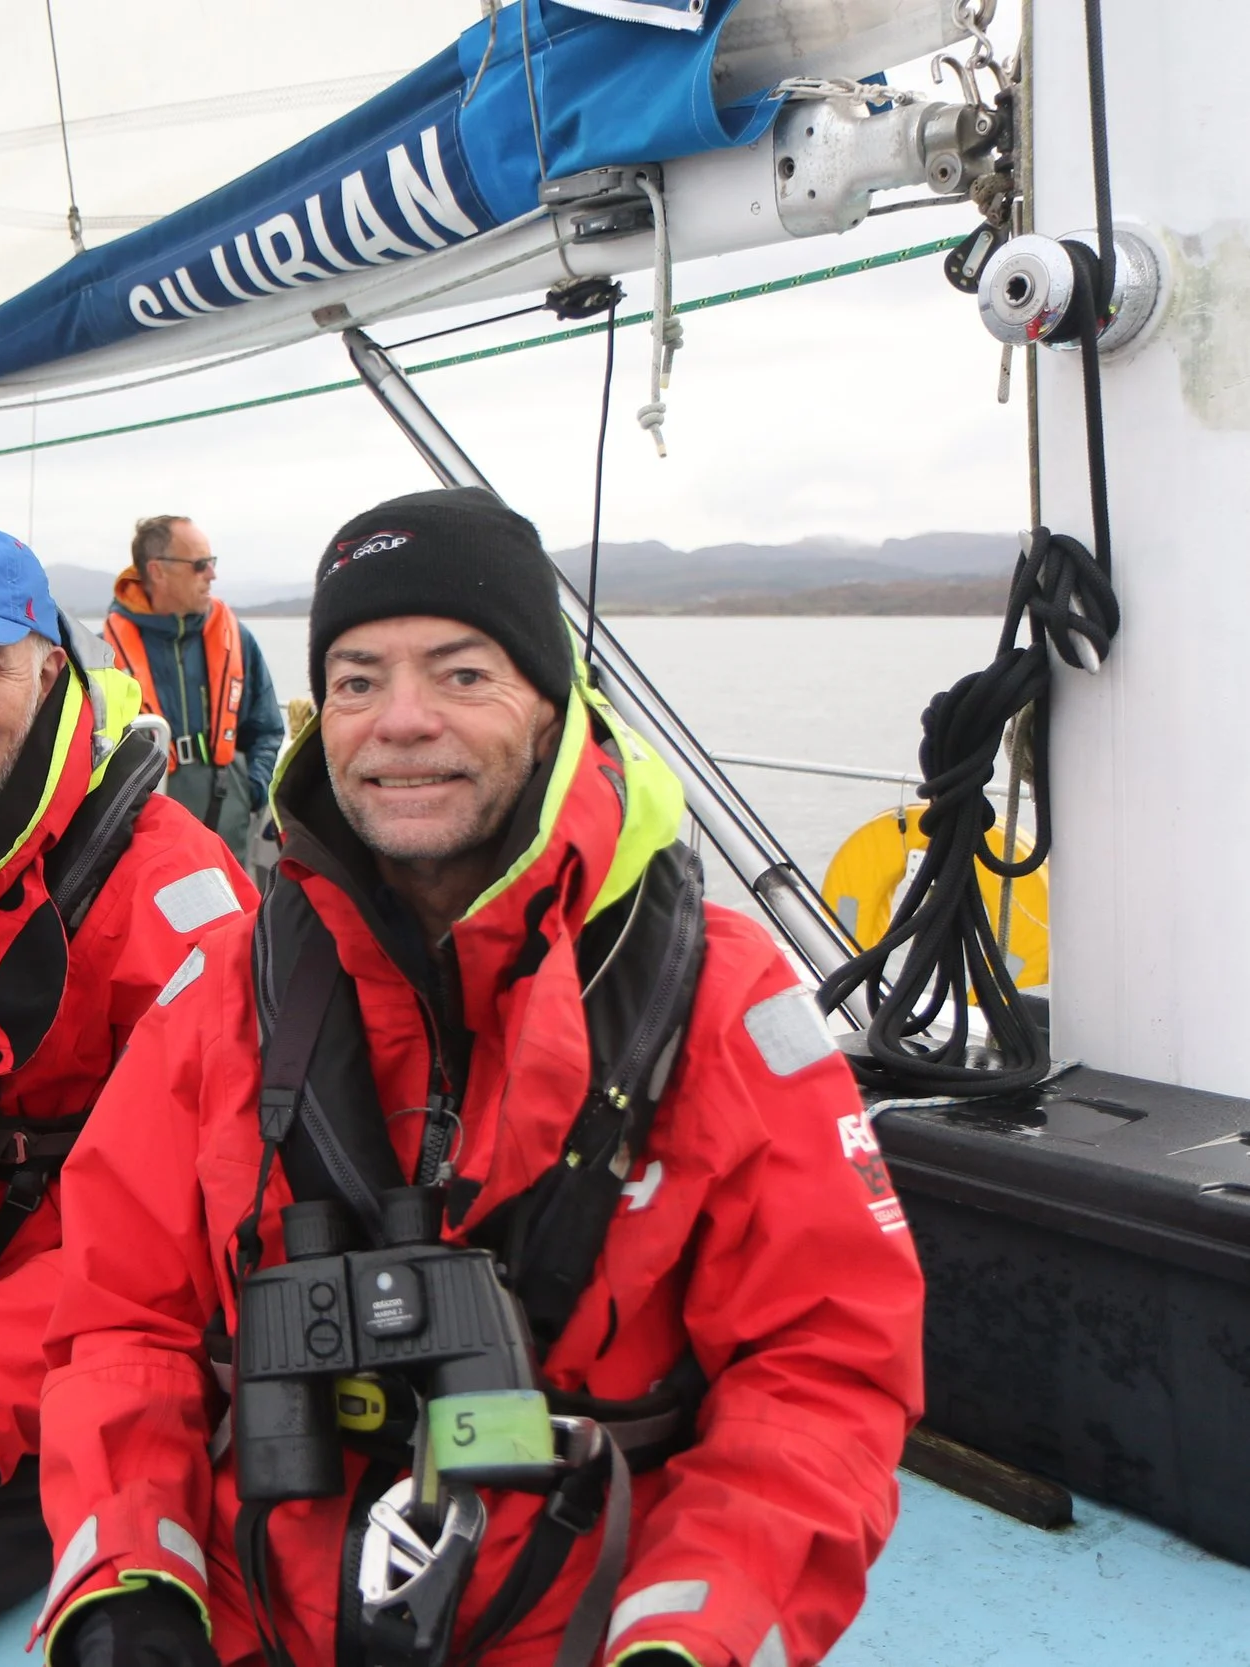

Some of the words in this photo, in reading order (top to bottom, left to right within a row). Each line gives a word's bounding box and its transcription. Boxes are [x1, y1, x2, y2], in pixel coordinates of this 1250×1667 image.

[129, 125, 479, 328] SILURIAN
[352, 537, 407, 560] GROUP
[452, 1411, 477, 1447] 5
